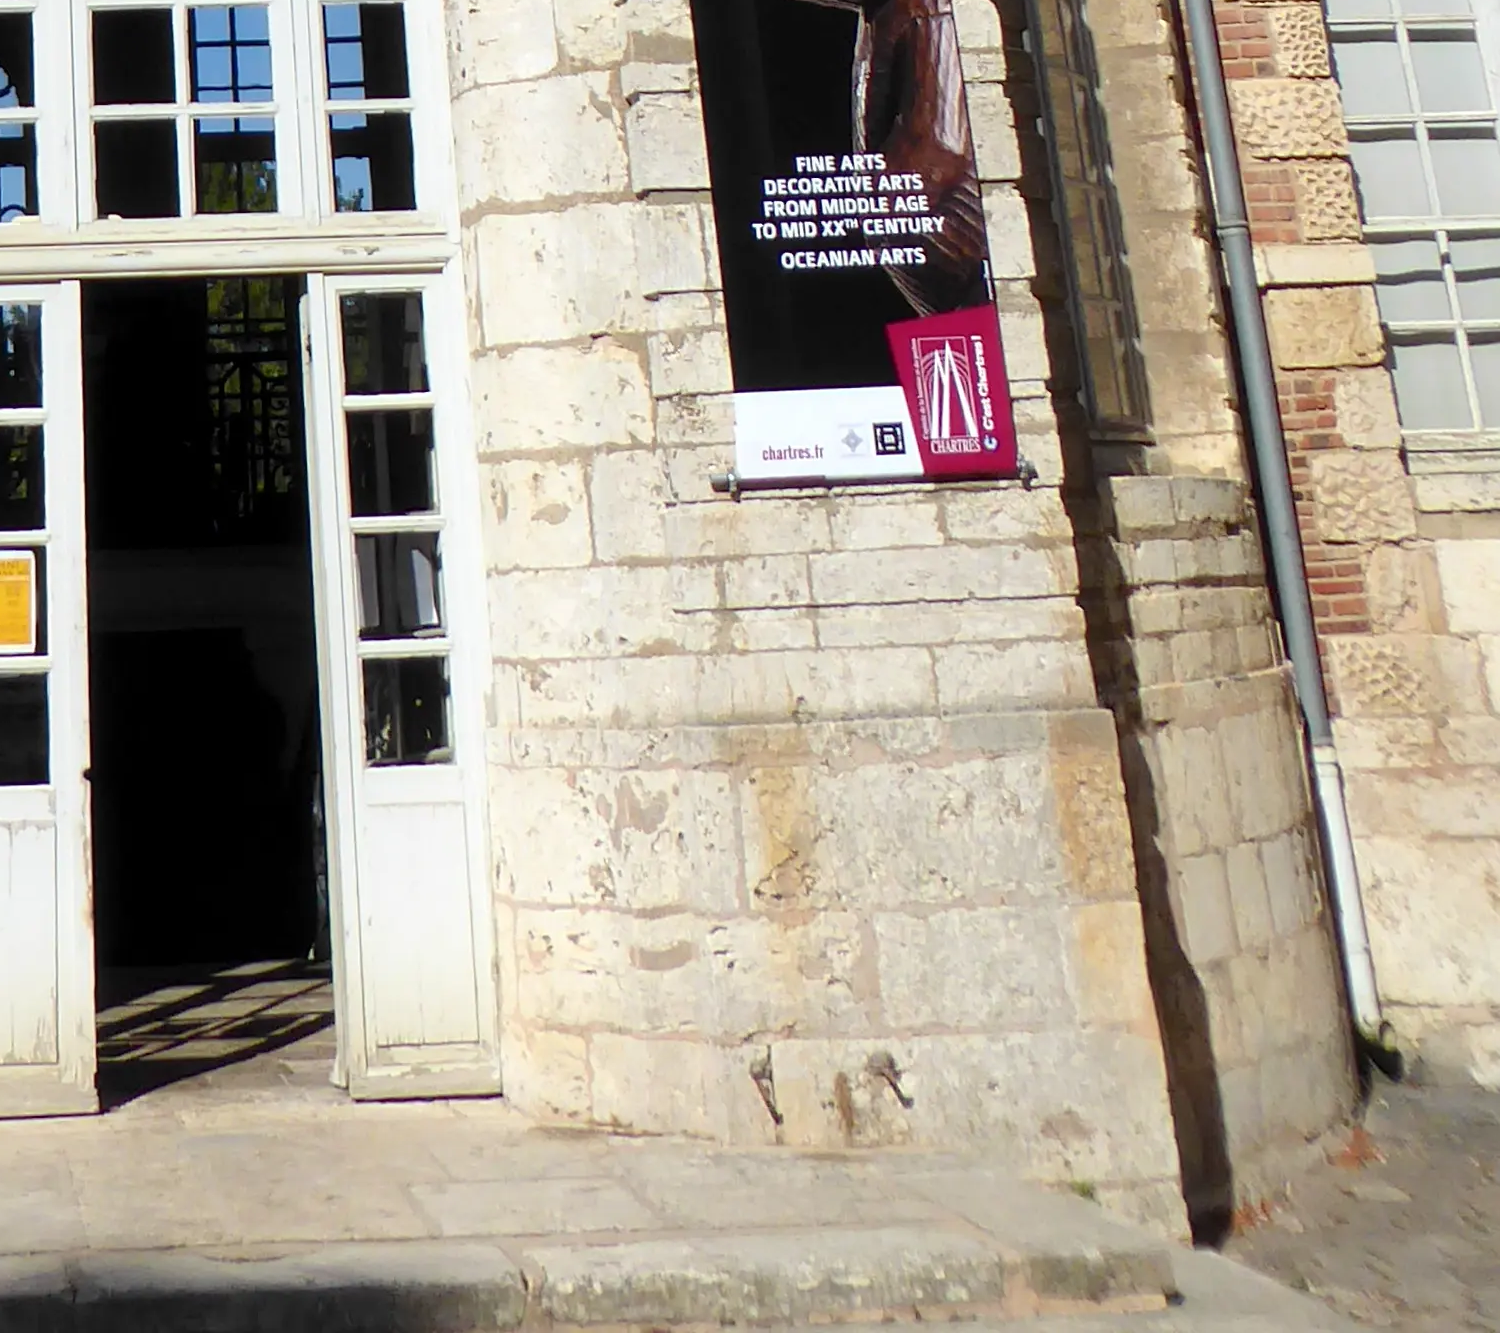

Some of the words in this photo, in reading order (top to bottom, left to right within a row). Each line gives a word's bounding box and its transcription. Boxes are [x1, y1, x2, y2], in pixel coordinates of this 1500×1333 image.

[796, 155, 836, 173] FINE
[841, 153, 886, 171] ARTS
[763, 175, 873, 196] DECORATIVE
[878, 174, 924, 191] ARTS
[763, 199, 817, 217] FROM
[821, 196, 889, 215] MIDDLE
[894, 195, 930, 212] AGE
[752, 222, 777, 239] TO
[781, 221, 817, 239] MID
[863, 216, 945, 235] CENTURY
[781, 249, 875, 268] OCEANIAN
[879, 247, 926, 265] ARTS
[762, 444, 825, 461] chartres.fr
[930, 438, 981, 453] CHARTRES
